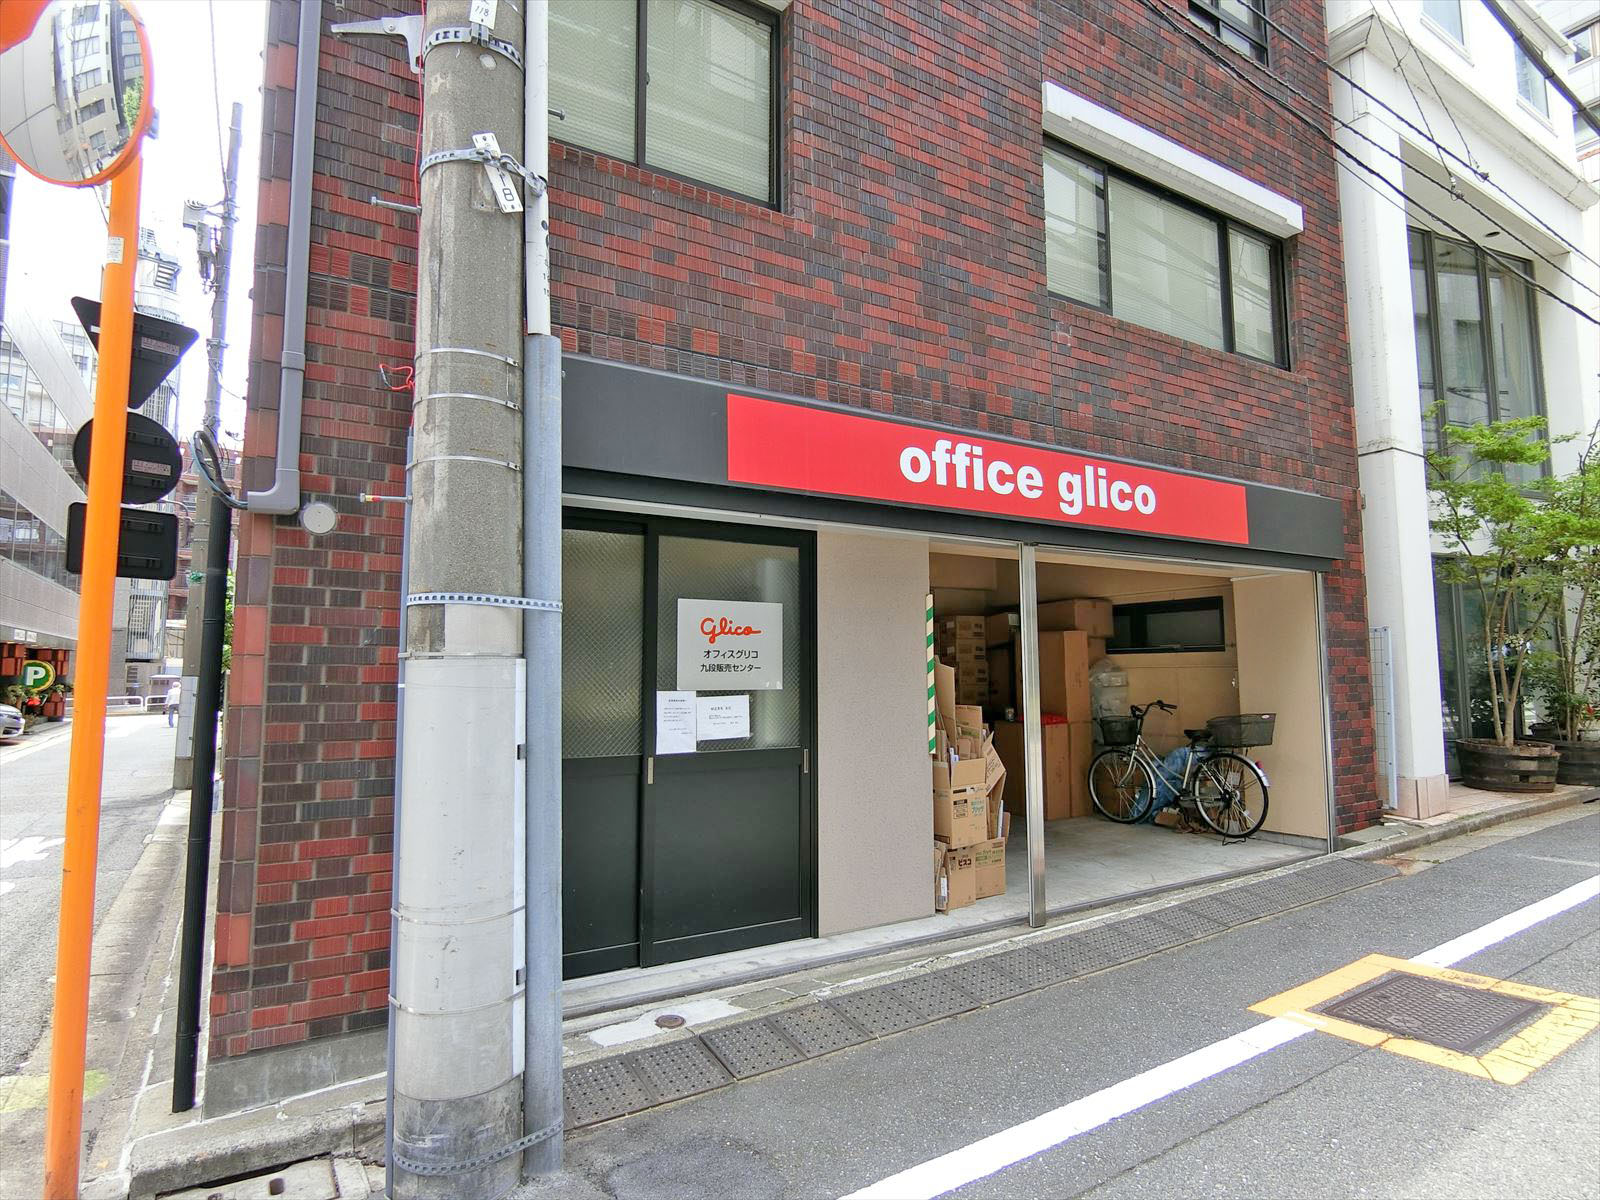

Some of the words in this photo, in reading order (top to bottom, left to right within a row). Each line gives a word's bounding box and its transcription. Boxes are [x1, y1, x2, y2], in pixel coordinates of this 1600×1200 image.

[900, 438, 1043, 500] office
[1057, 464, 1157, 516] glico
[703, 650, 759, 659] オフィスグリコ
[700, 664, 762, 673] 九段販売センター
[25, 666, 46, 686] P
